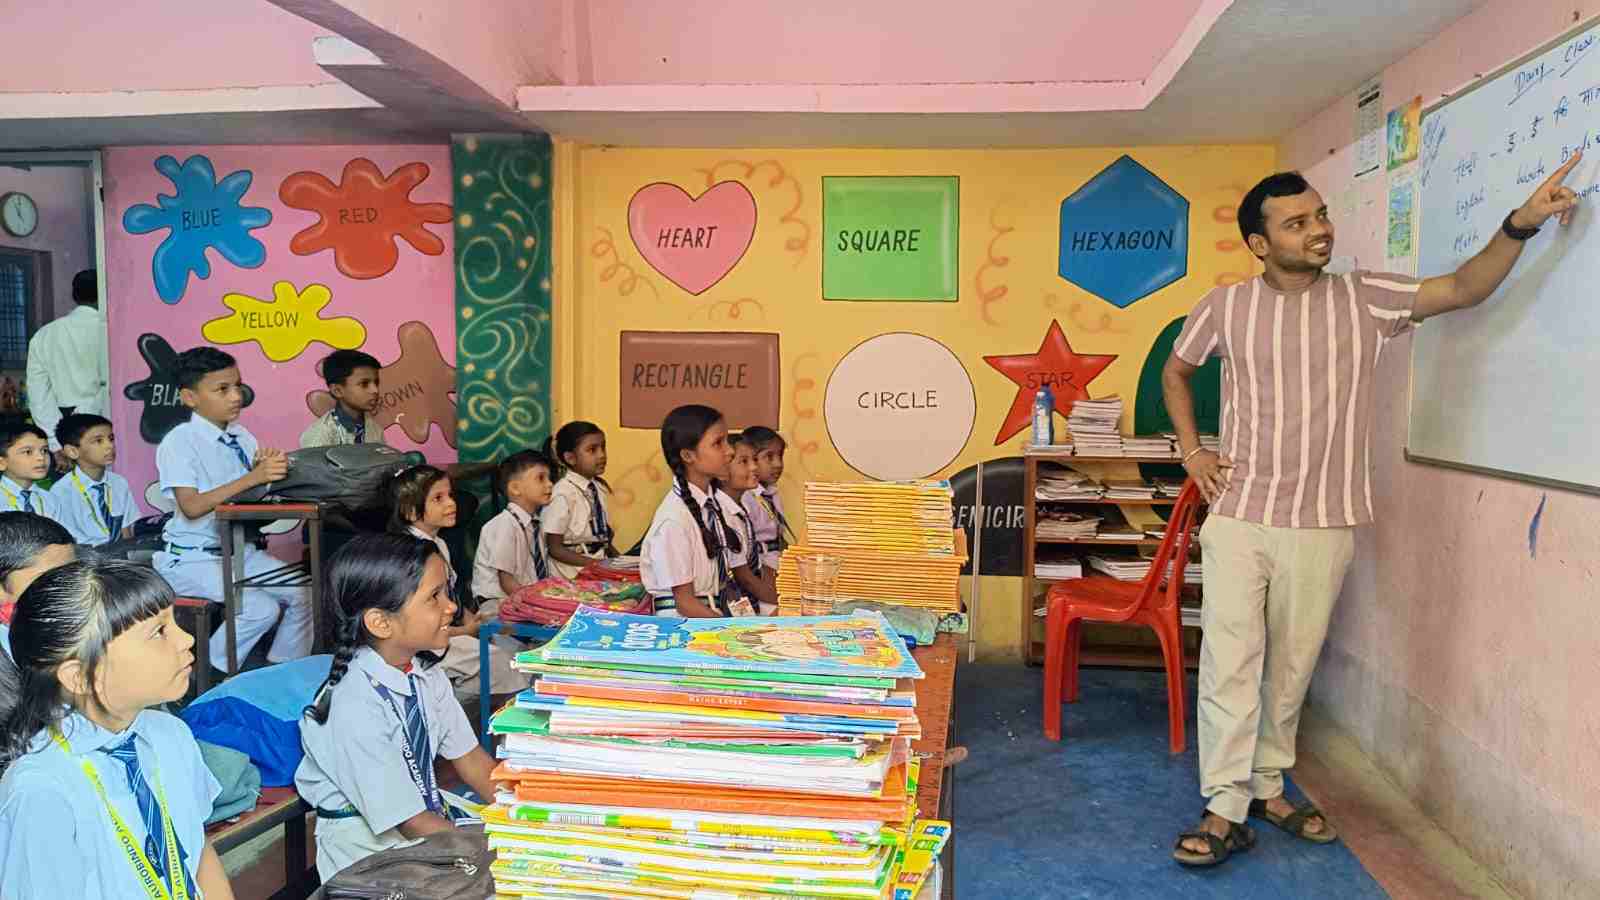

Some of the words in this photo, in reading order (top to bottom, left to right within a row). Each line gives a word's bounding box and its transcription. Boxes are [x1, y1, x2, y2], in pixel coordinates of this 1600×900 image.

[181, 207, 221, 230] BLUE
[339, 206, 378, 224] RED
[657, 225, 718, 250] HEART
[837, 228, 921, 253] SQUARE
[1071, 229, 1174, 252] HEXAGON
[240, 310, 299, 329] YELLOW
[631, 363, 748, 389] RECTANGLE
[1025, 371, 1079, 390] STAR
[151, 383, 184, 407] BLA
[857, 390, 938, 410] CIRCLE
[407, 757, 429, 797] ACADEMY
[121, 834, 162, 899] AUROBINDO
